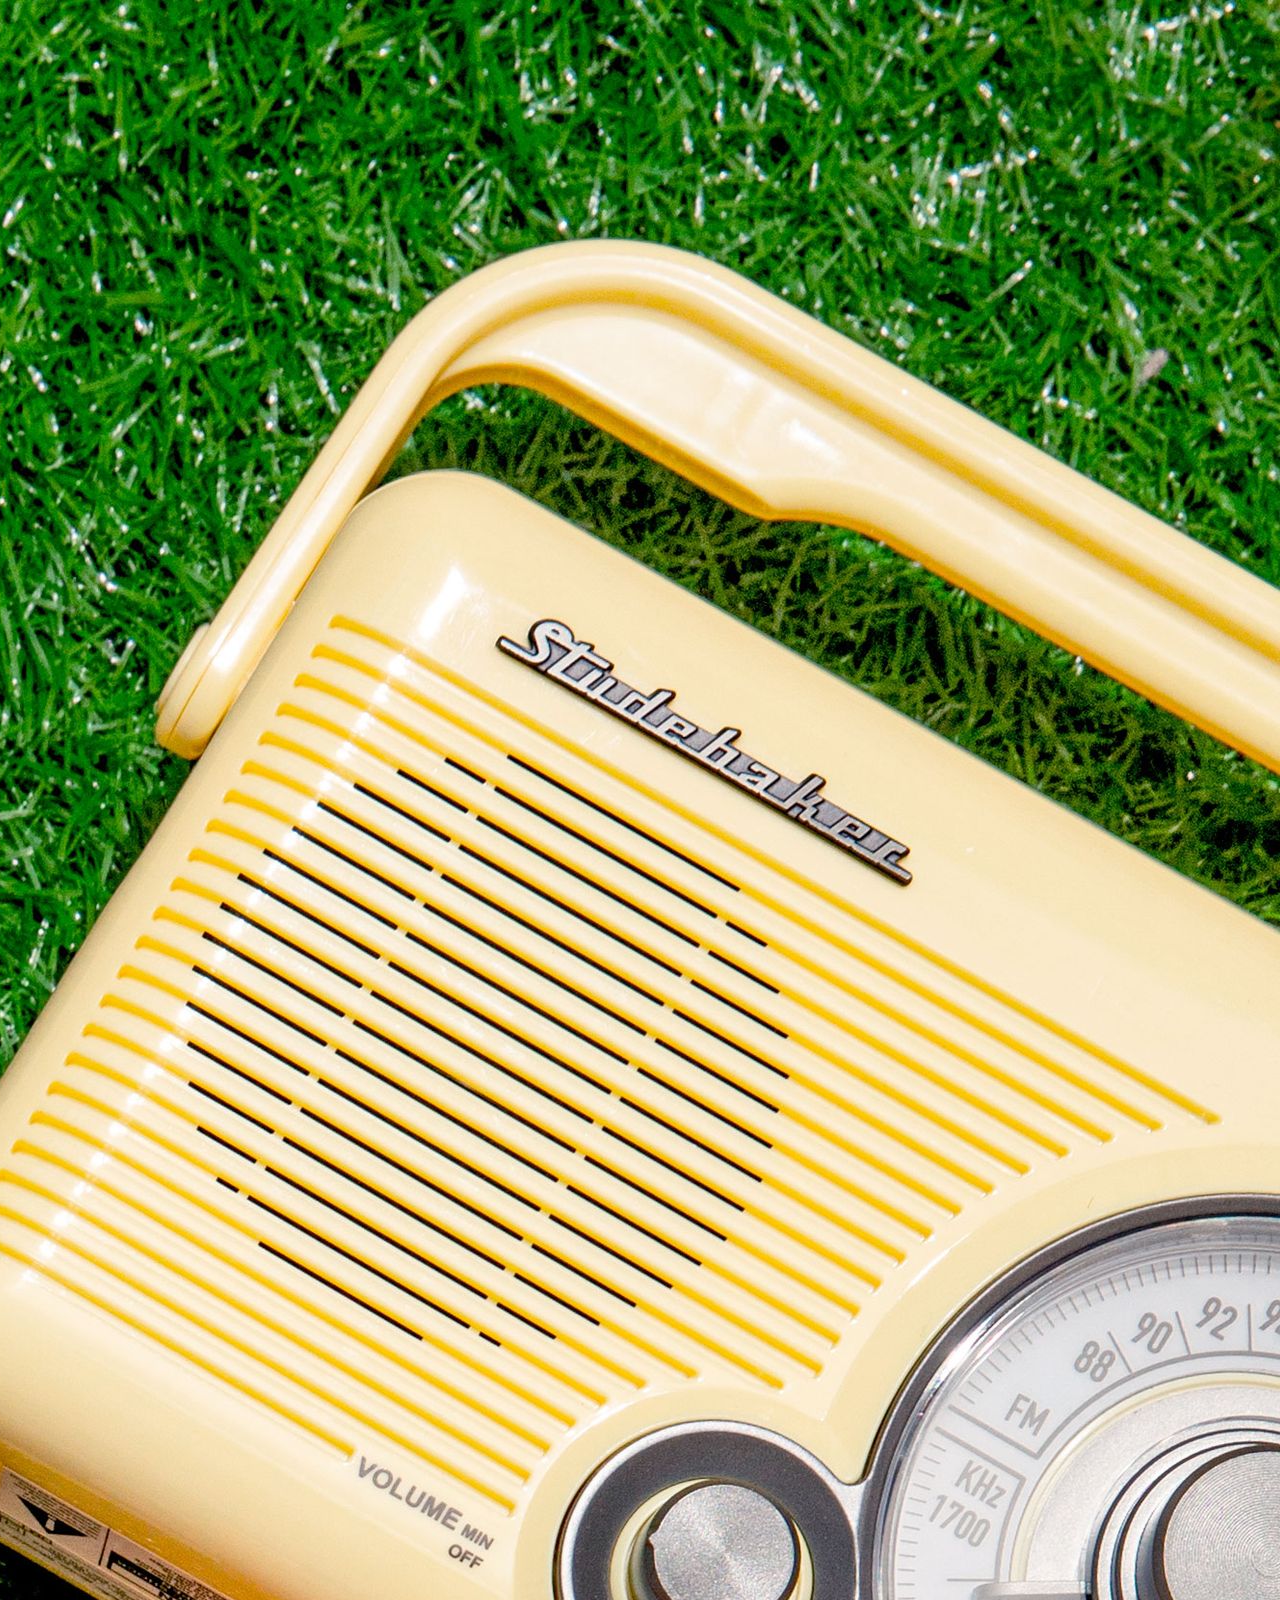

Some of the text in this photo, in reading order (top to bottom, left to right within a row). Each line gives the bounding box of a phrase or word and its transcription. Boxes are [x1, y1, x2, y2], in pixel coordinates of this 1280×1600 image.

[496, 618, 914, 886] Studebaker
[1131, 1312, 1173, 1354] 90
[1195, 1297, 1238, 1342] 92
[1259, 1299, 1280, 1336] 9
[1073, 1340, 1117, 1383] 88
[1004, 1393, 1051, 1437] FM
[358, 1456, 495, 1550] VOLUME MIN
[954, 1459, 1008, 1509] KHz
[928, 1493, 992, 1548] 1700
[448, 1544, 485, 1569] OFF
